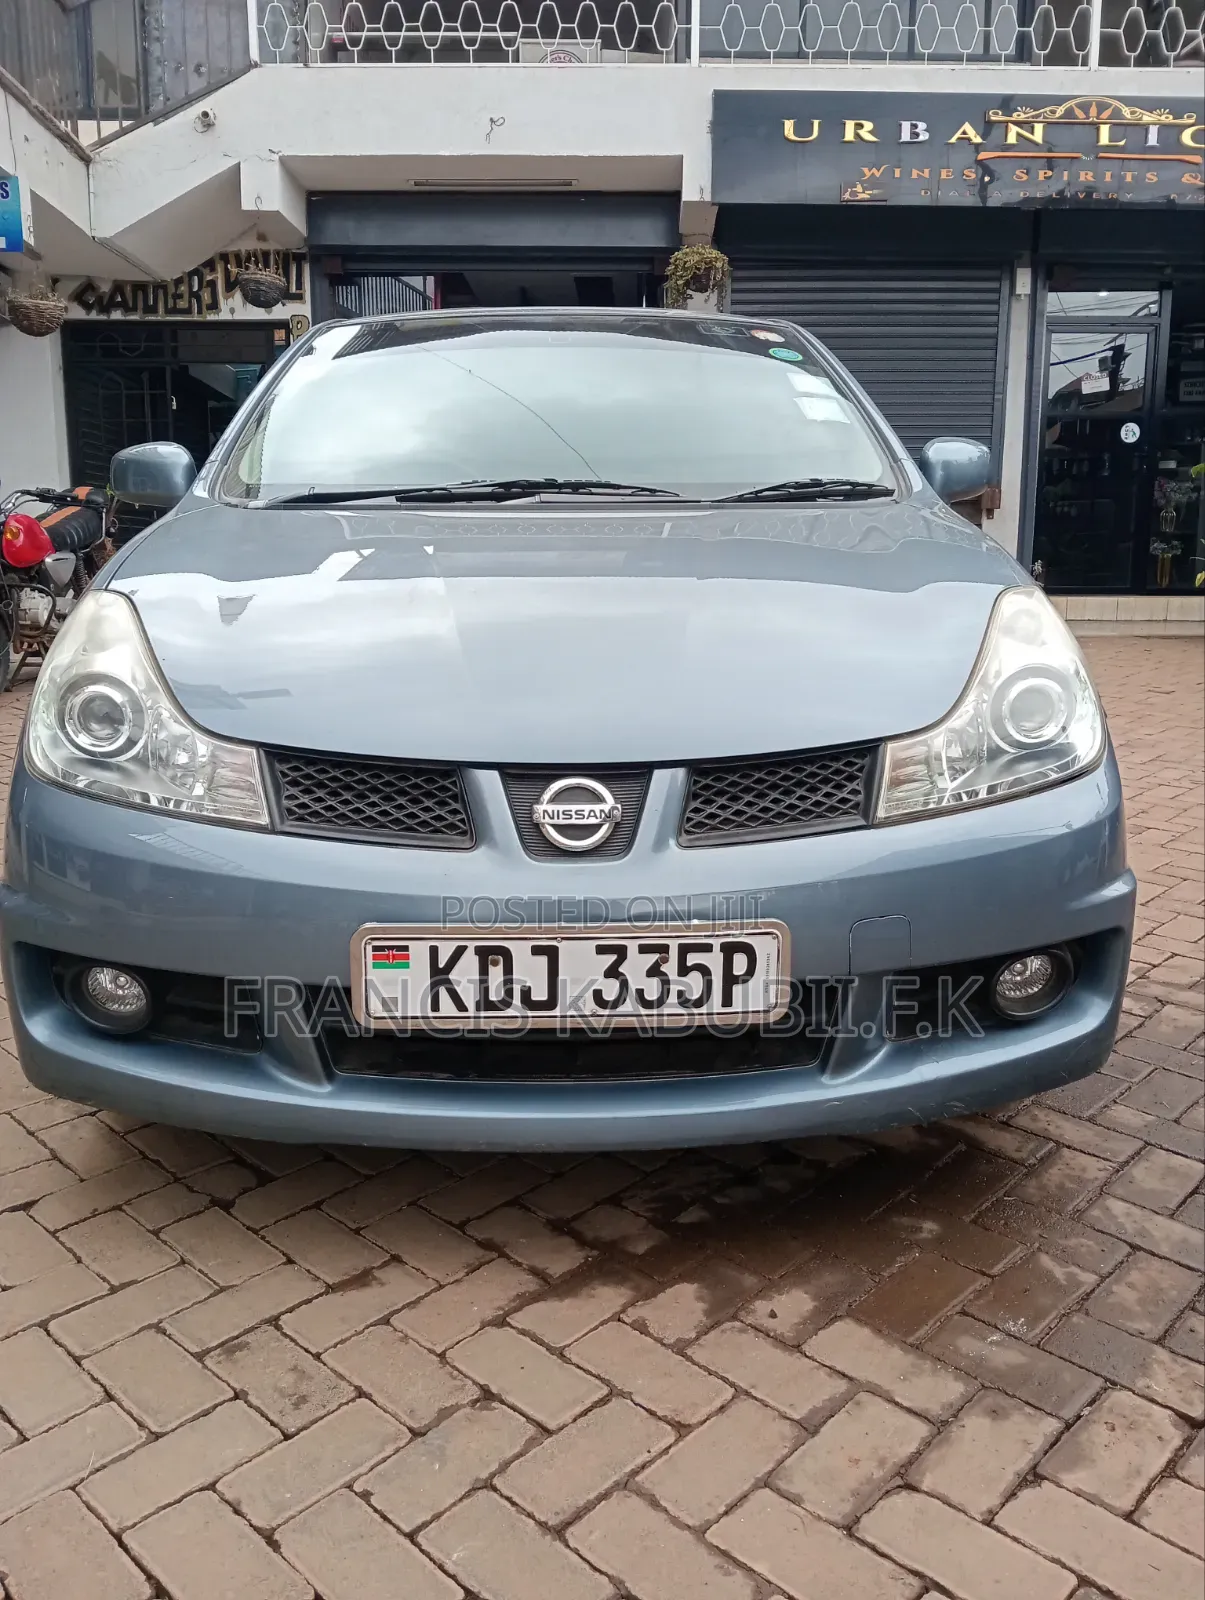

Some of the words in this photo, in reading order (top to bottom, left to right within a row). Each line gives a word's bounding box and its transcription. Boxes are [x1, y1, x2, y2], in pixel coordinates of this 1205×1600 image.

[782, 118, 1048, 145] URBAN
[1012, 169, 1159, 183] SPIRITS
[1181, 171, 1204, 186] &
[1020, 191, 1134, 199] DELIVERY
[541, 808, 612, 821] NISSAN
[429, 944, 560, 1013] KDJ
[592, 941, 758, 1011] 335P
